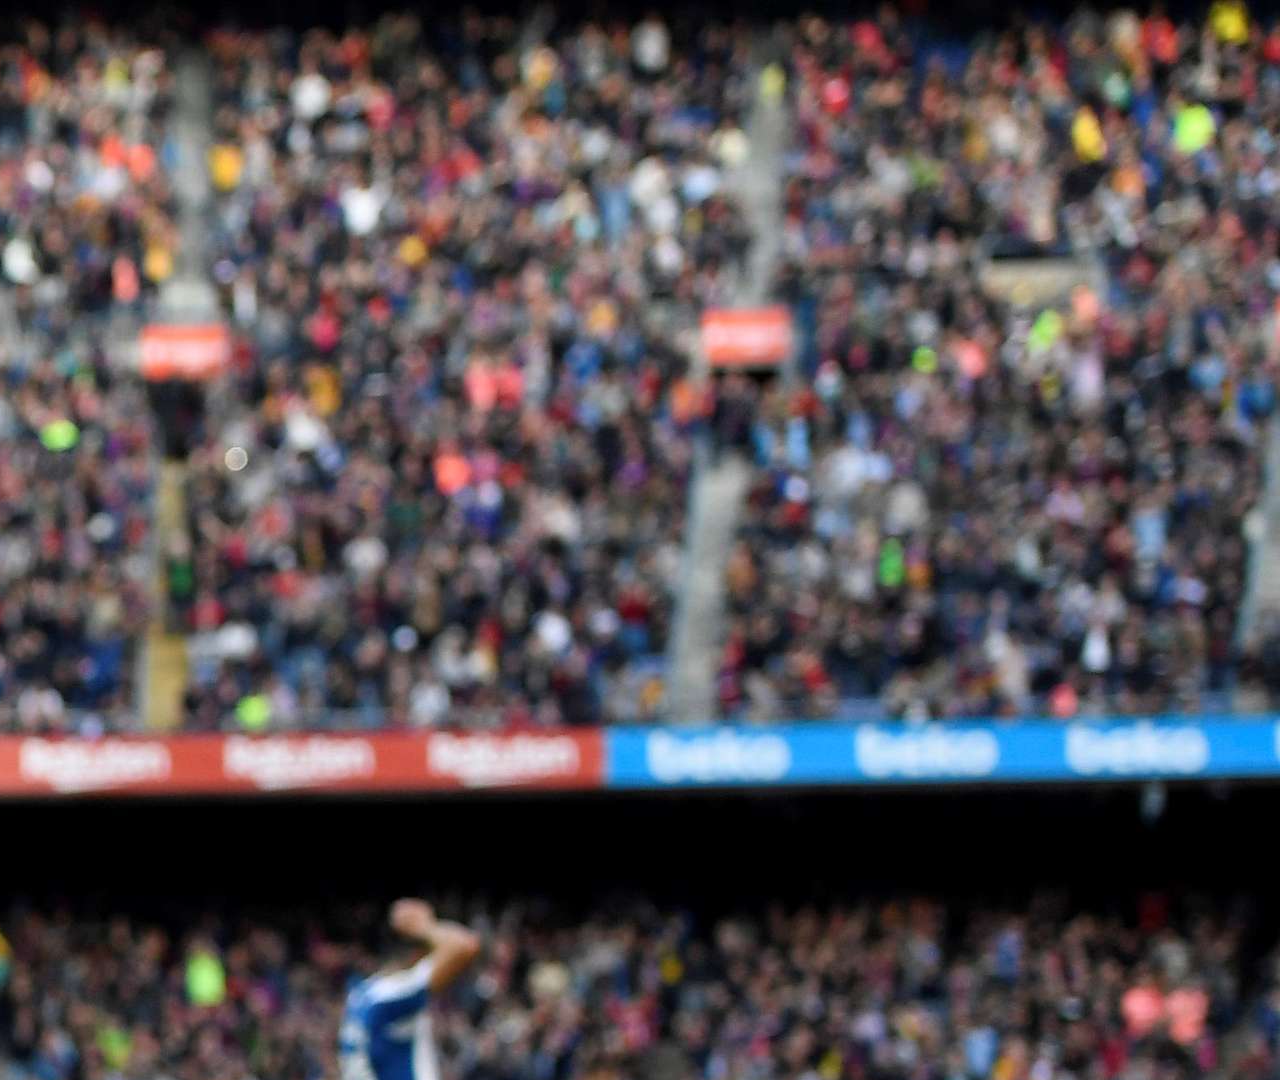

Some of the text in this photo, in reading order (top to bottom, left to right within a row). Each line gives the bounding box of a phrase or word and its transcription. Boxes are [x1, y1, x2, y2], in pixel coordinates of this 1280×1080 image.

[648, 731, 790, 778] beko
[856, 726, 998, 774] beko
[1067, 723, 1208, 772] beko
